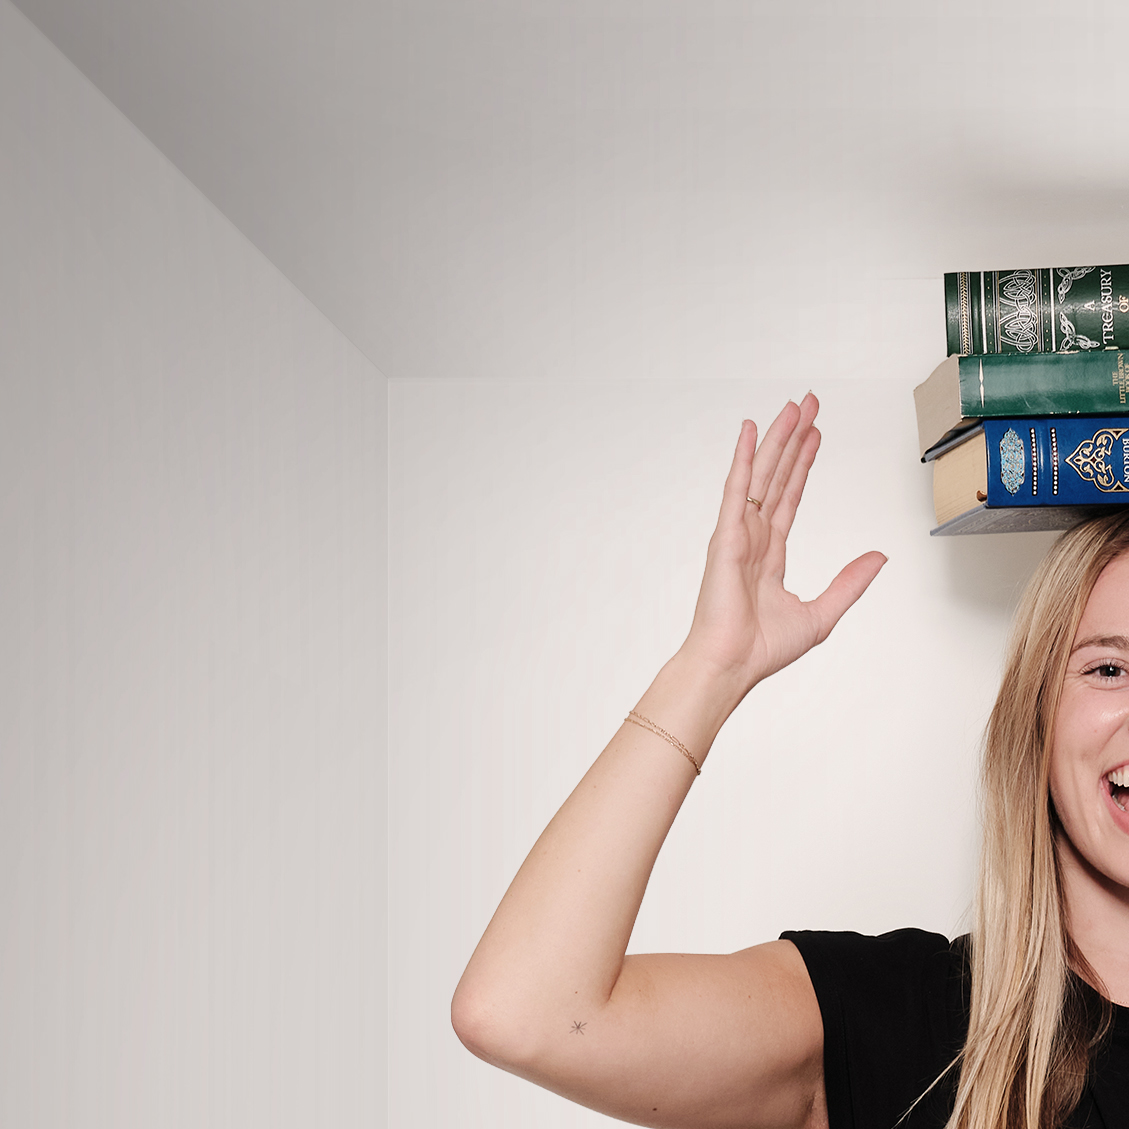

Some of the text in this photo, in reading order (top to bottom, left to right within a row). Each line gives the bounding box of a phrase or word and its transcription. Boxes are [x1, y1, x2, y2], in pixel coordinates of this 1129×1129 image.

[1084, 300, 1095, 311] A
[1100, 269, 1115, 344] TREASURY
[1119, 295, 1129, 313] OF
[1117, 353, 1125, 379] BROWN
